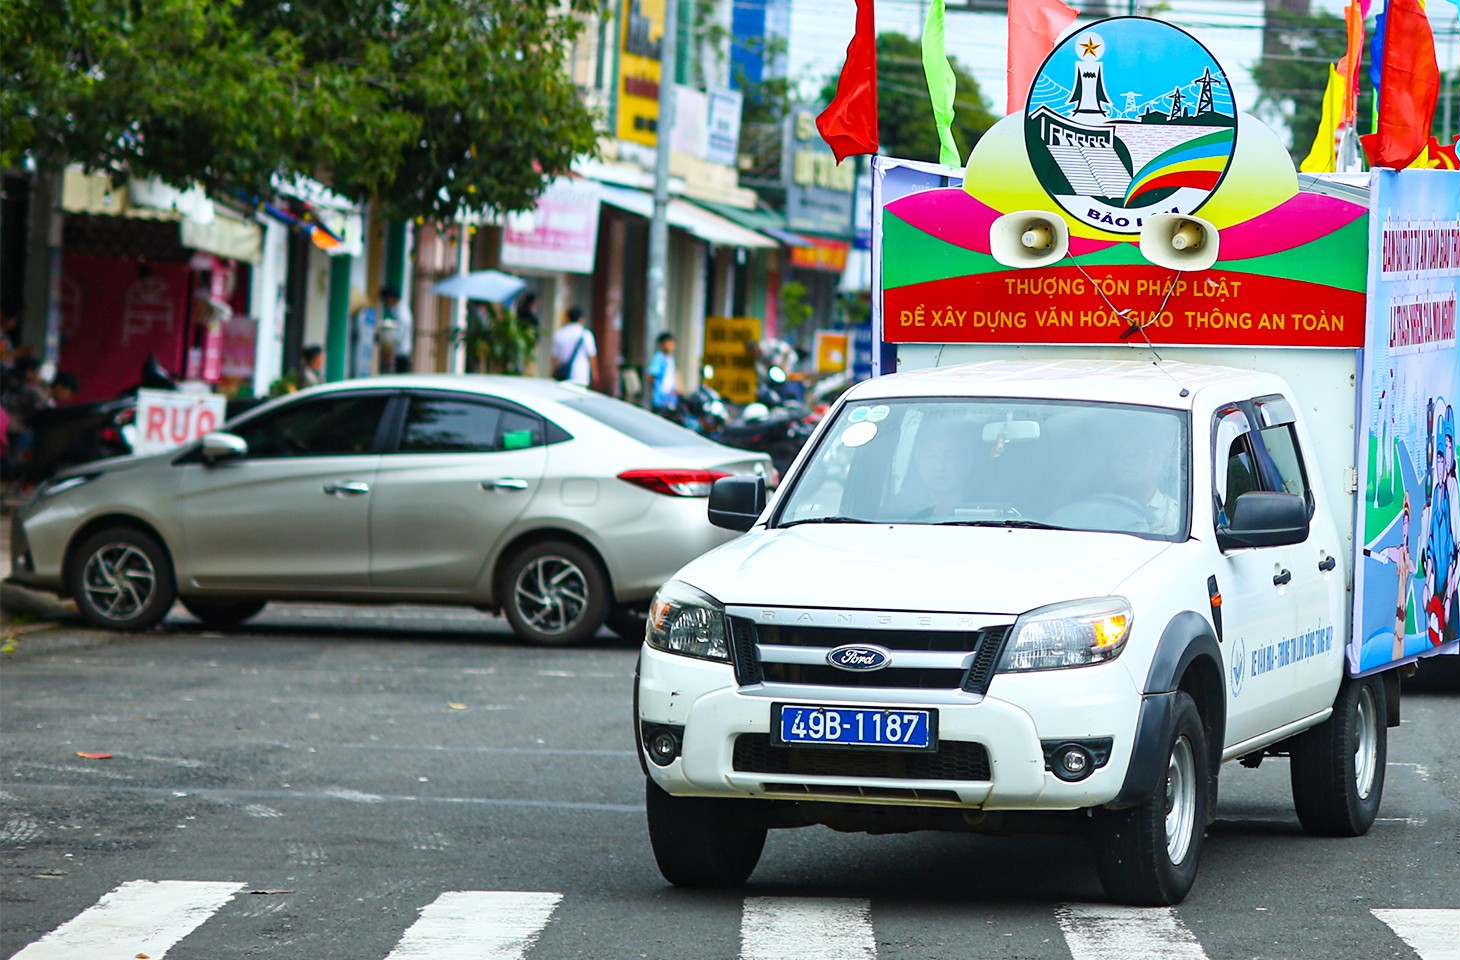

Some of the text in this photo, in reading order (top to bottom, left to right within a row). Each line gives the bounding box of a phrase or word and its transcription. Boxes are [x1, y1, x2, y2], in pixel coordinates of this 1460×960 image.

[1087, 208, 1130, 227] BẢO
[1005, 274, 1242, 303] THƯỢNG TÔN PHÁP LUẬT
[900, 303, 1345, 333] ĐỂ XÂY DỰNG VĂN HÓA GIAO THÔNG AN TOÀN
[760, 610, 974, 627] RANGER
[841, 649, 875, 666] Ford
[791, 710, 920, 743] 49B-1187
